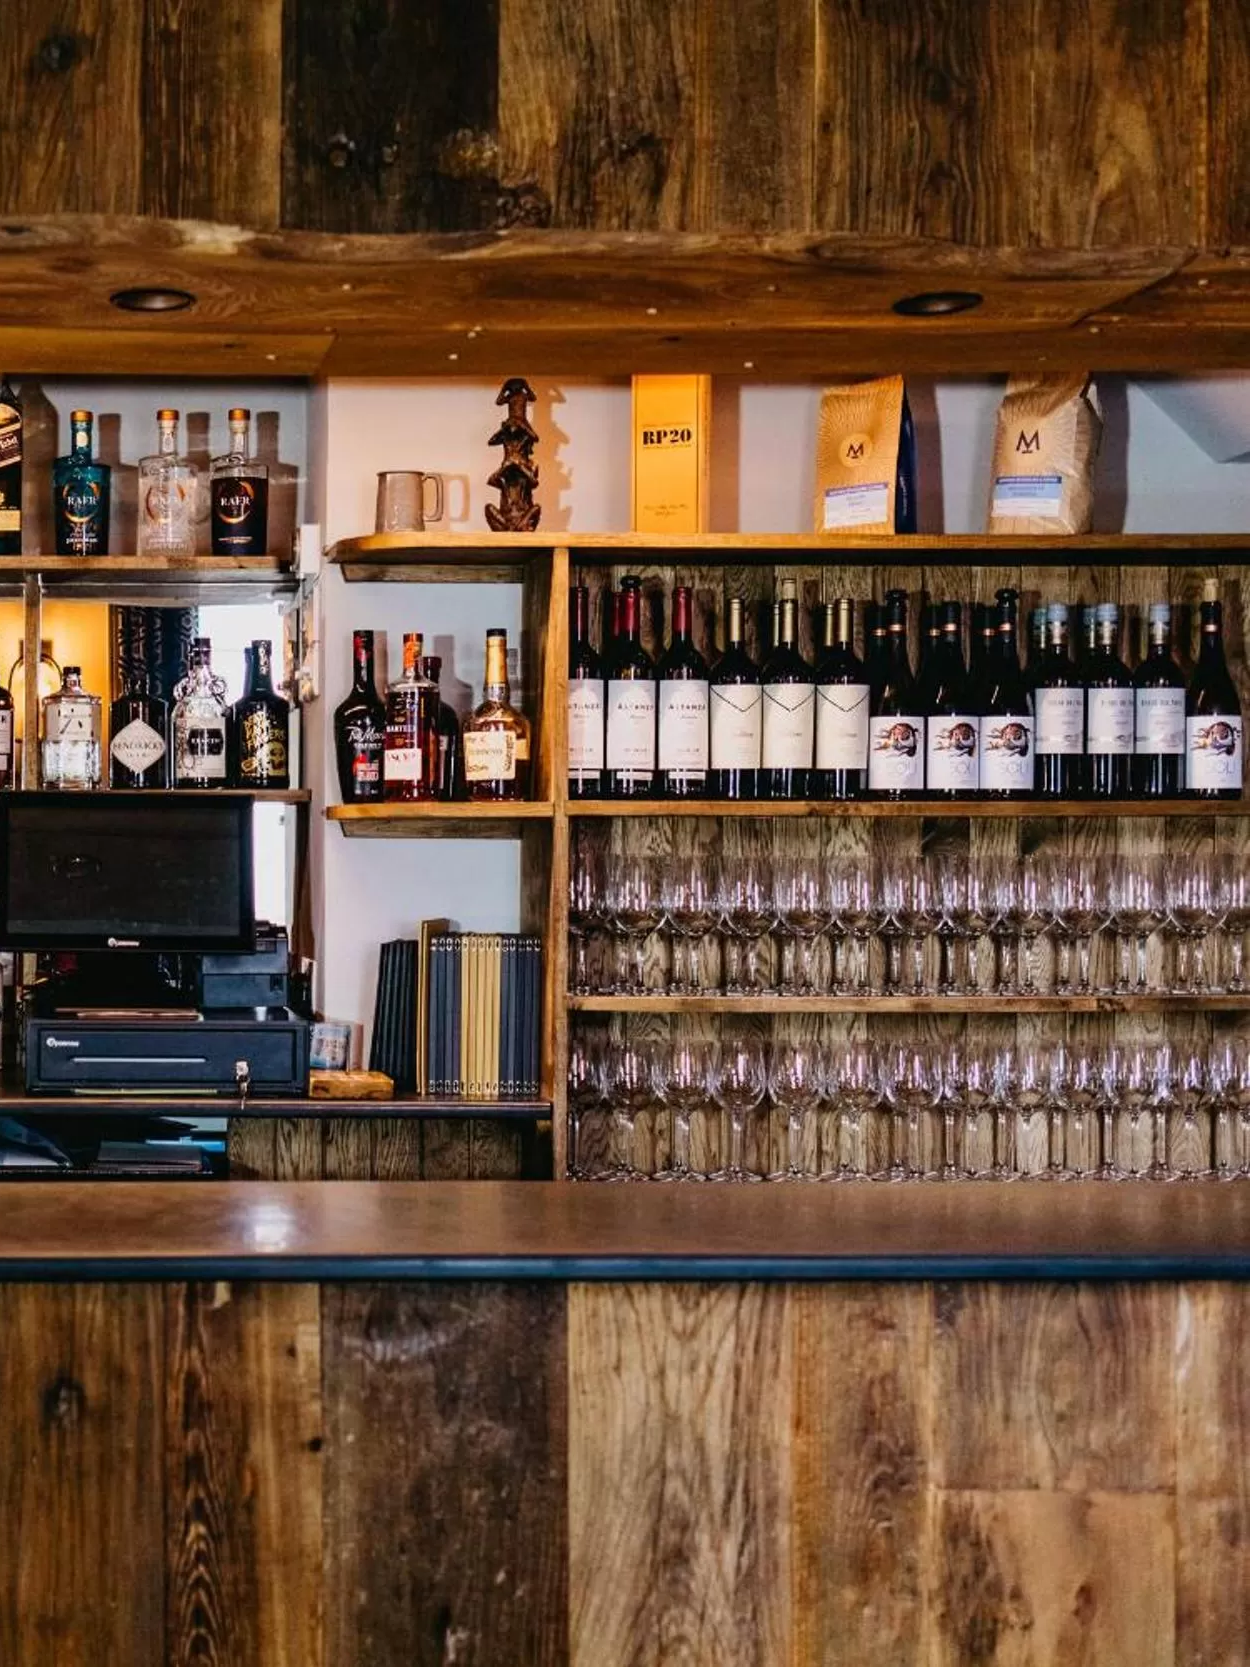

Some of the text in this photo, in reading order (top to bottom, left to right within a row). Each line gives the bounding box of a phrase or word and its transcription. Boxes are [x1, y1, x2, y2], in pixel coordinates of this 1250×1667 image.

[643, 428, 692, 445] RP20
[1016, 429, 1040, 454] M
[846, 443, 864, 459] M
